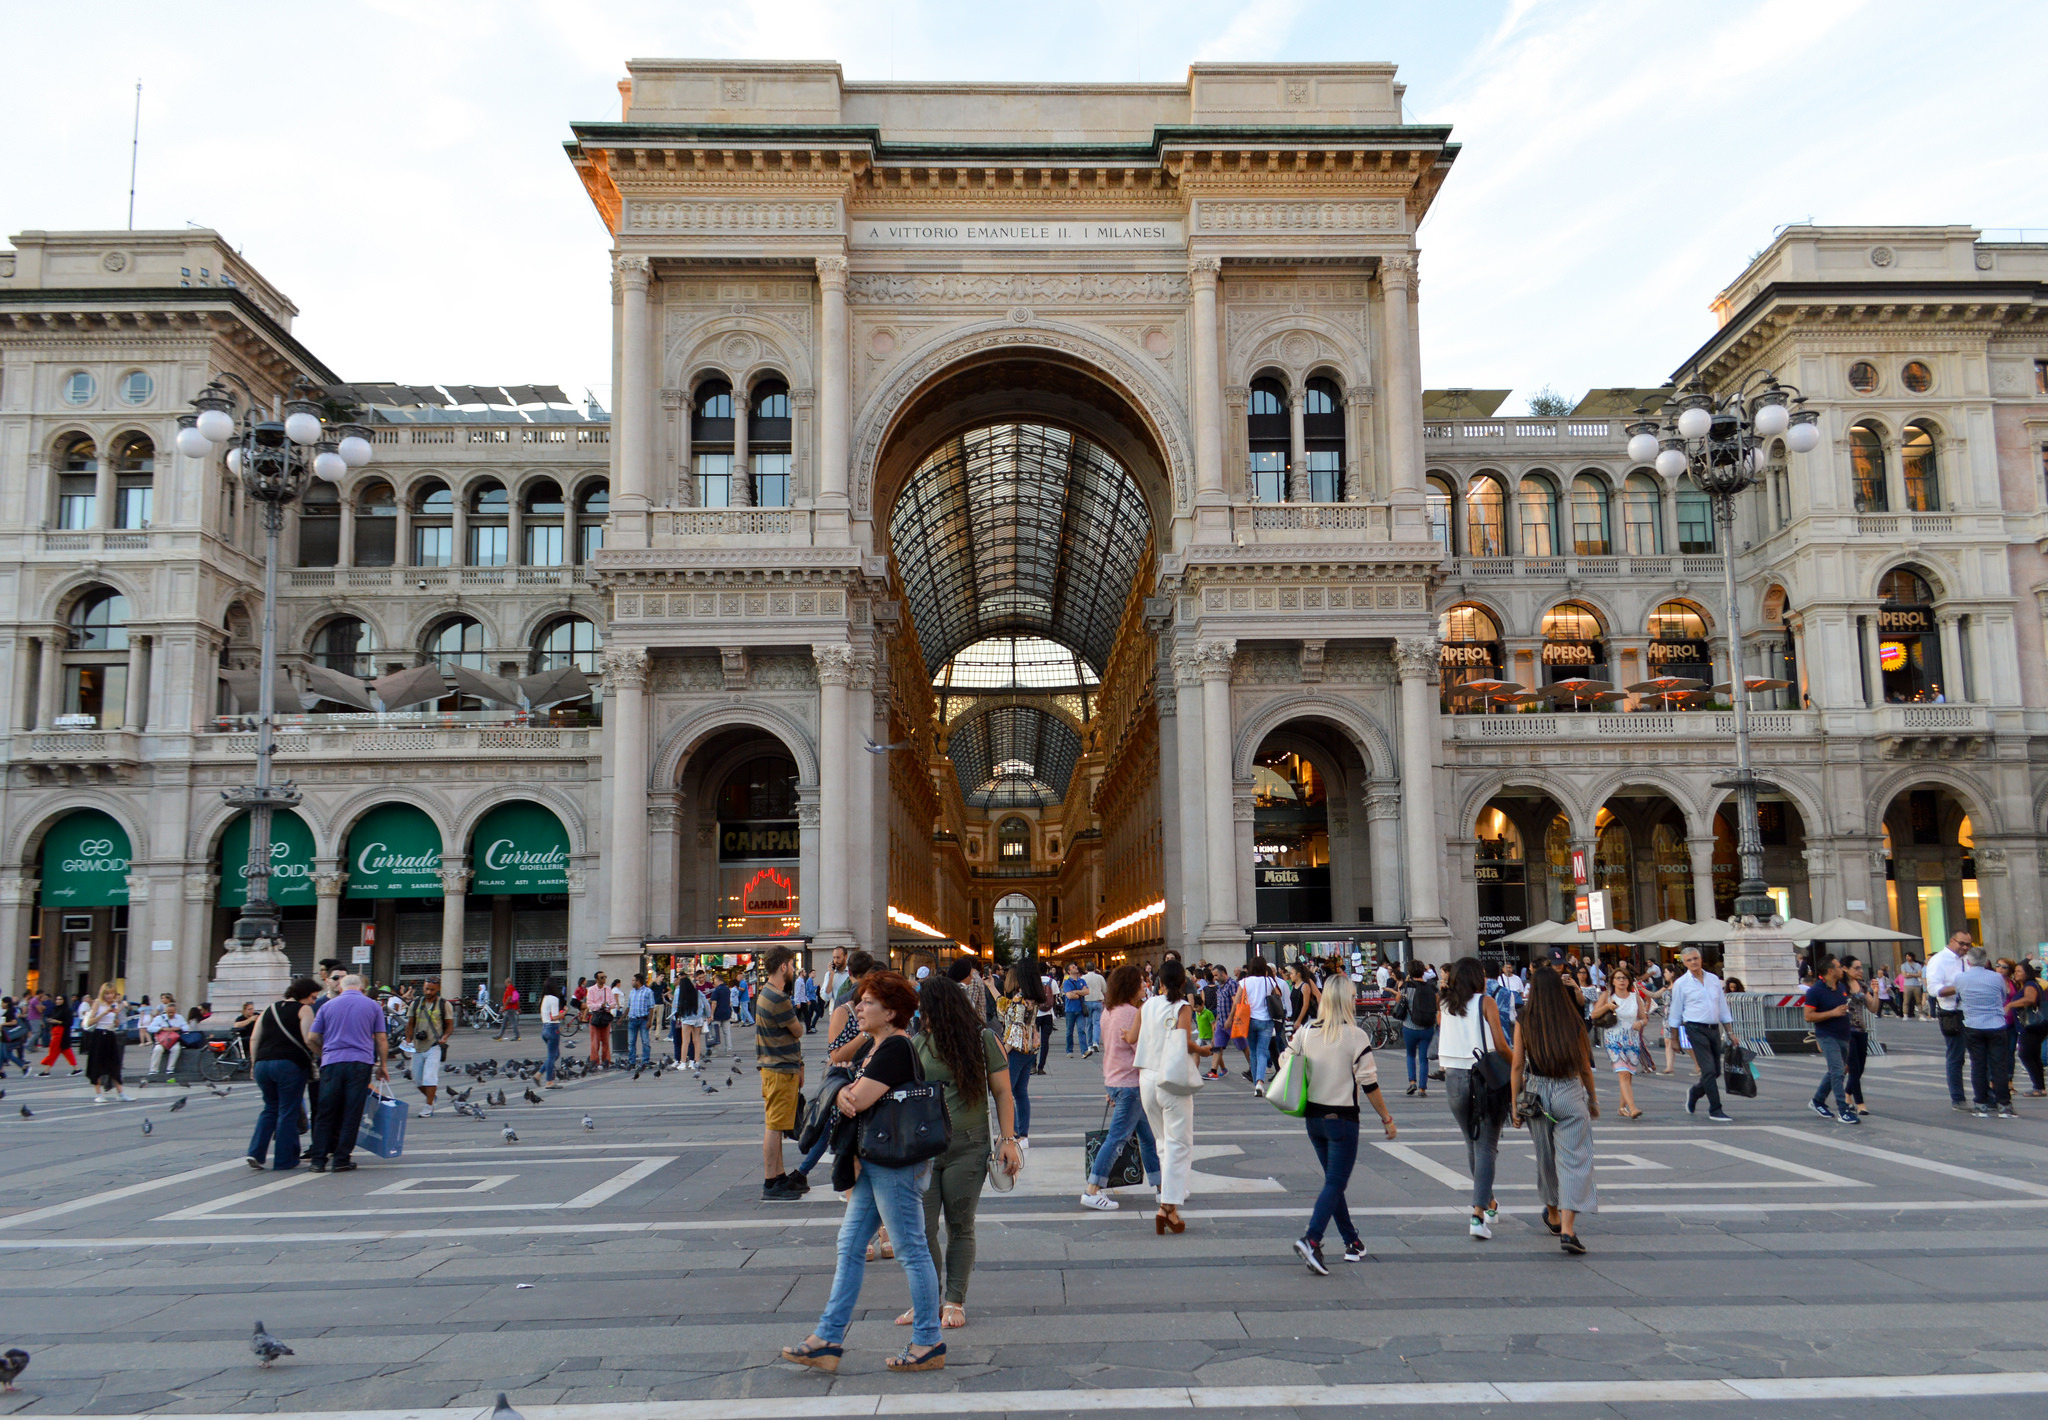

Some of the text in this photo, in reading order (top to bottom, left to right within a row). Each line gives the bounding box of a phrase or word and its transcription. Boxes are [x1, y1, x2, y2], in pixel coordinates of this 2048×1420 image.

[869, 227, 879, 238] A
[889, 227, 958, 238] VITTORIO
[967, 227, 1049, 238] EMANUELE
[1058, 227, 1071, 238] II.
[1097, 227, 1165, 238] MILANESI
[1440, 645, 1491, 661] APEROL
[1543, 643, 1595, 659] APEROL
[1648, 642, 1700, 658] APEROL
[327, 712, 376, 721] TERRAZZA
[378, 711, 412, 720] DUOMO
[357, 842, 440, 875] Currado
[485, 839, 566, 871] Currado
[519, 863, 565, 871] GIOIELLERIE
[1475, 867, 1499, 879] otta
[1552, 864, 1625, 874] RESRANTS
[1573, 855, 1587, 879] M
[1657, 864, 1688, 873] FOOD
[1264, 870, 1300, 883] Motta
[748, 900, 788, 910] CAMPARI
